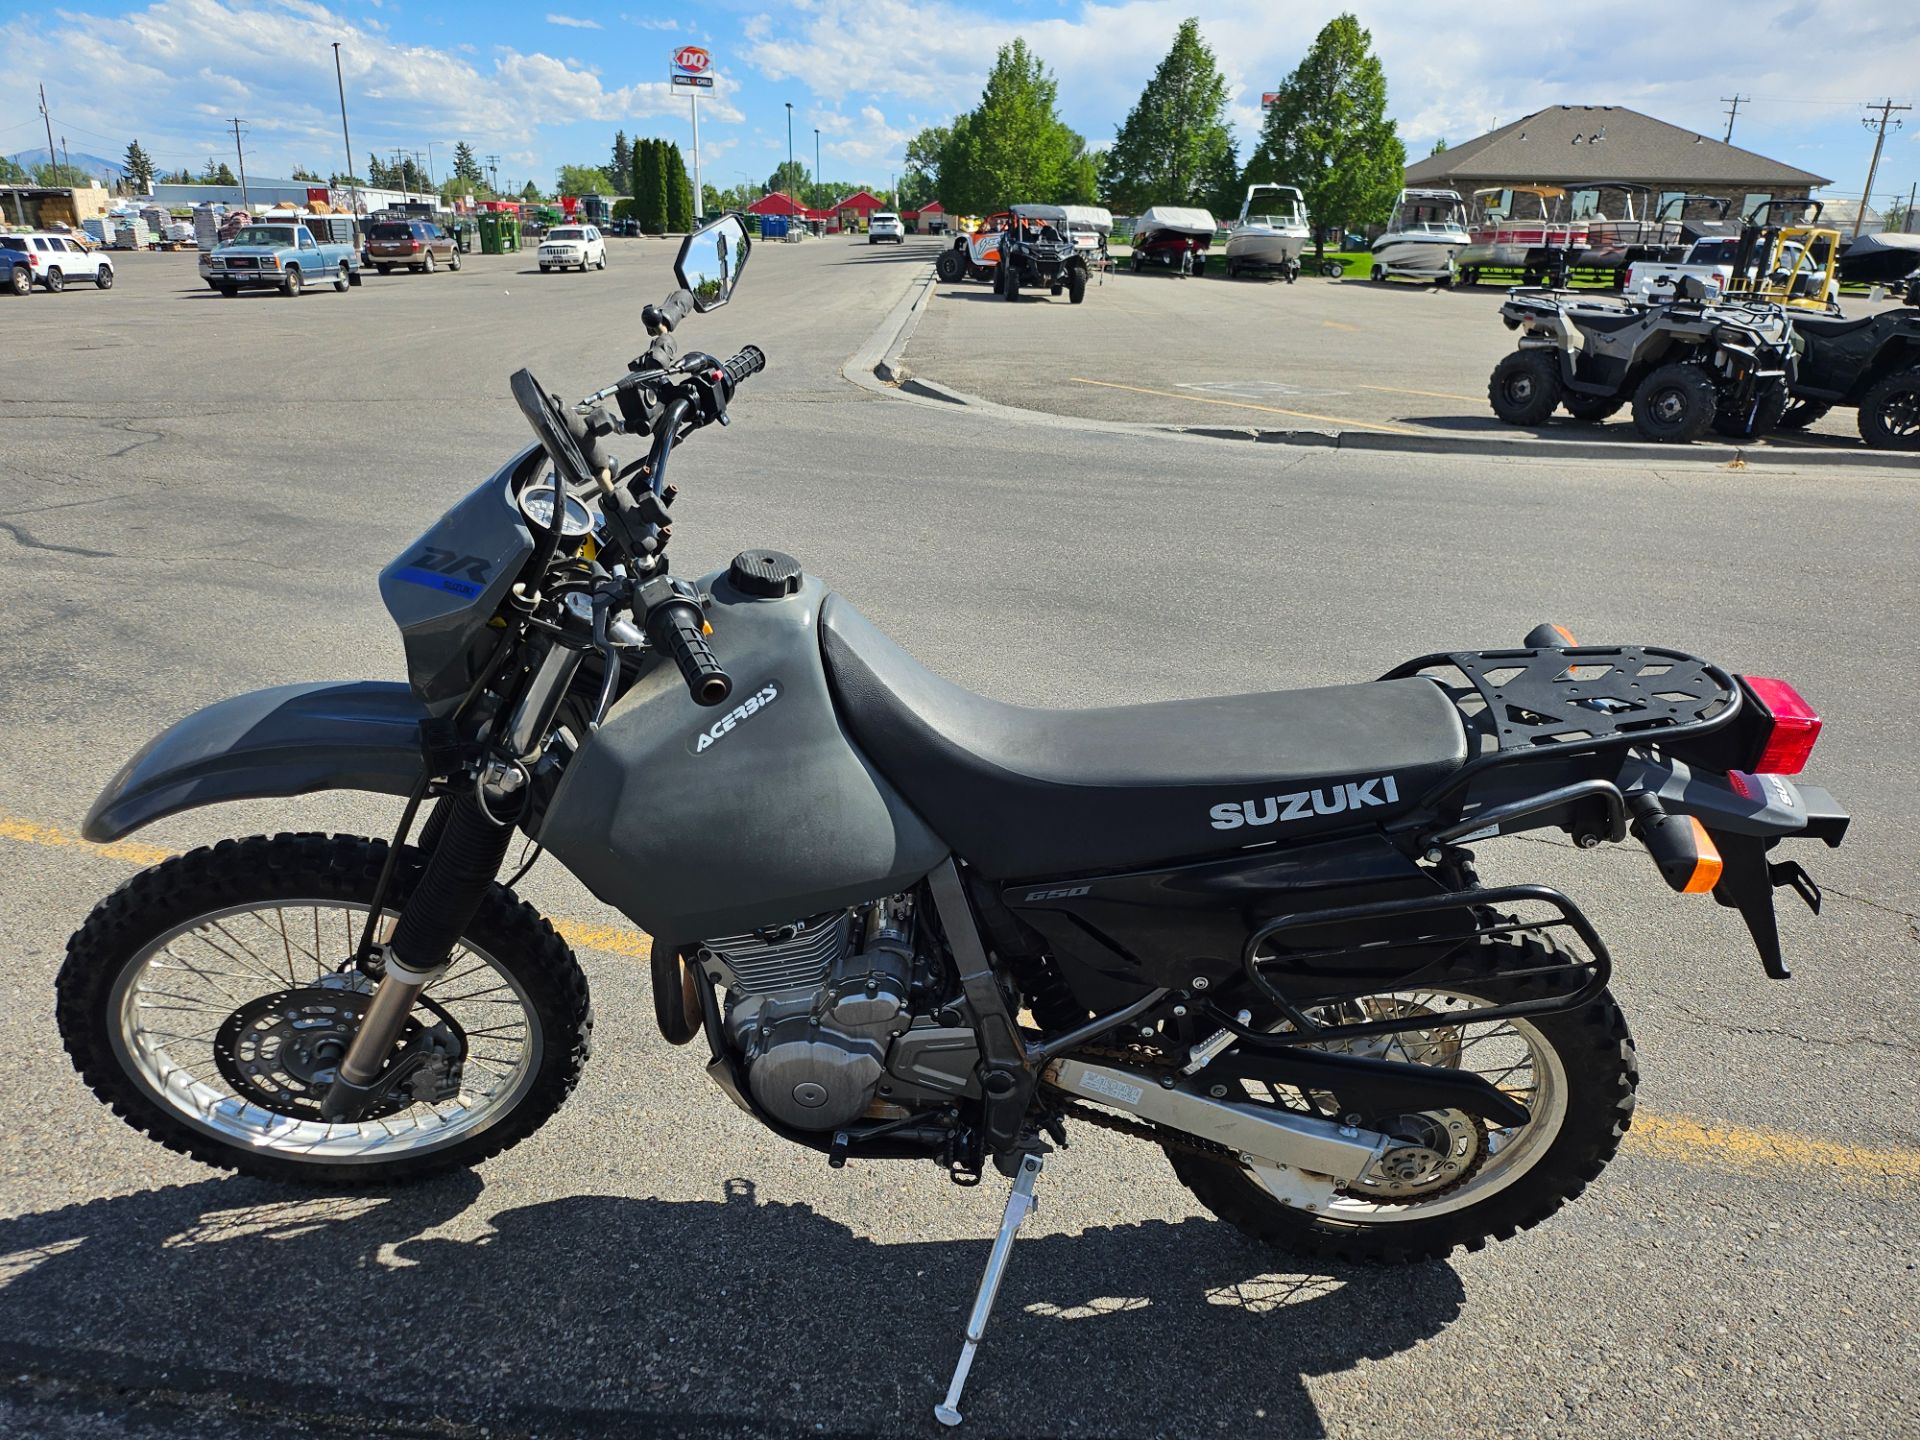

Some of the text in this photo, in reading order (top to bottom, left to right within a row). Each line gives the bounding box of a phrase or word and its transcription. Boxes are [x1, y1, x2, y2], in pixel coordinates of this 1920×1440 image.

[682, 52, 705, 69] DQ
[410, 546, 492, 584] DR
[696, 684, 778, 753] ACERBIS
[1209, 775, 1401, 830] SUZUKI
[1024, 885, 1093, 902] 650
